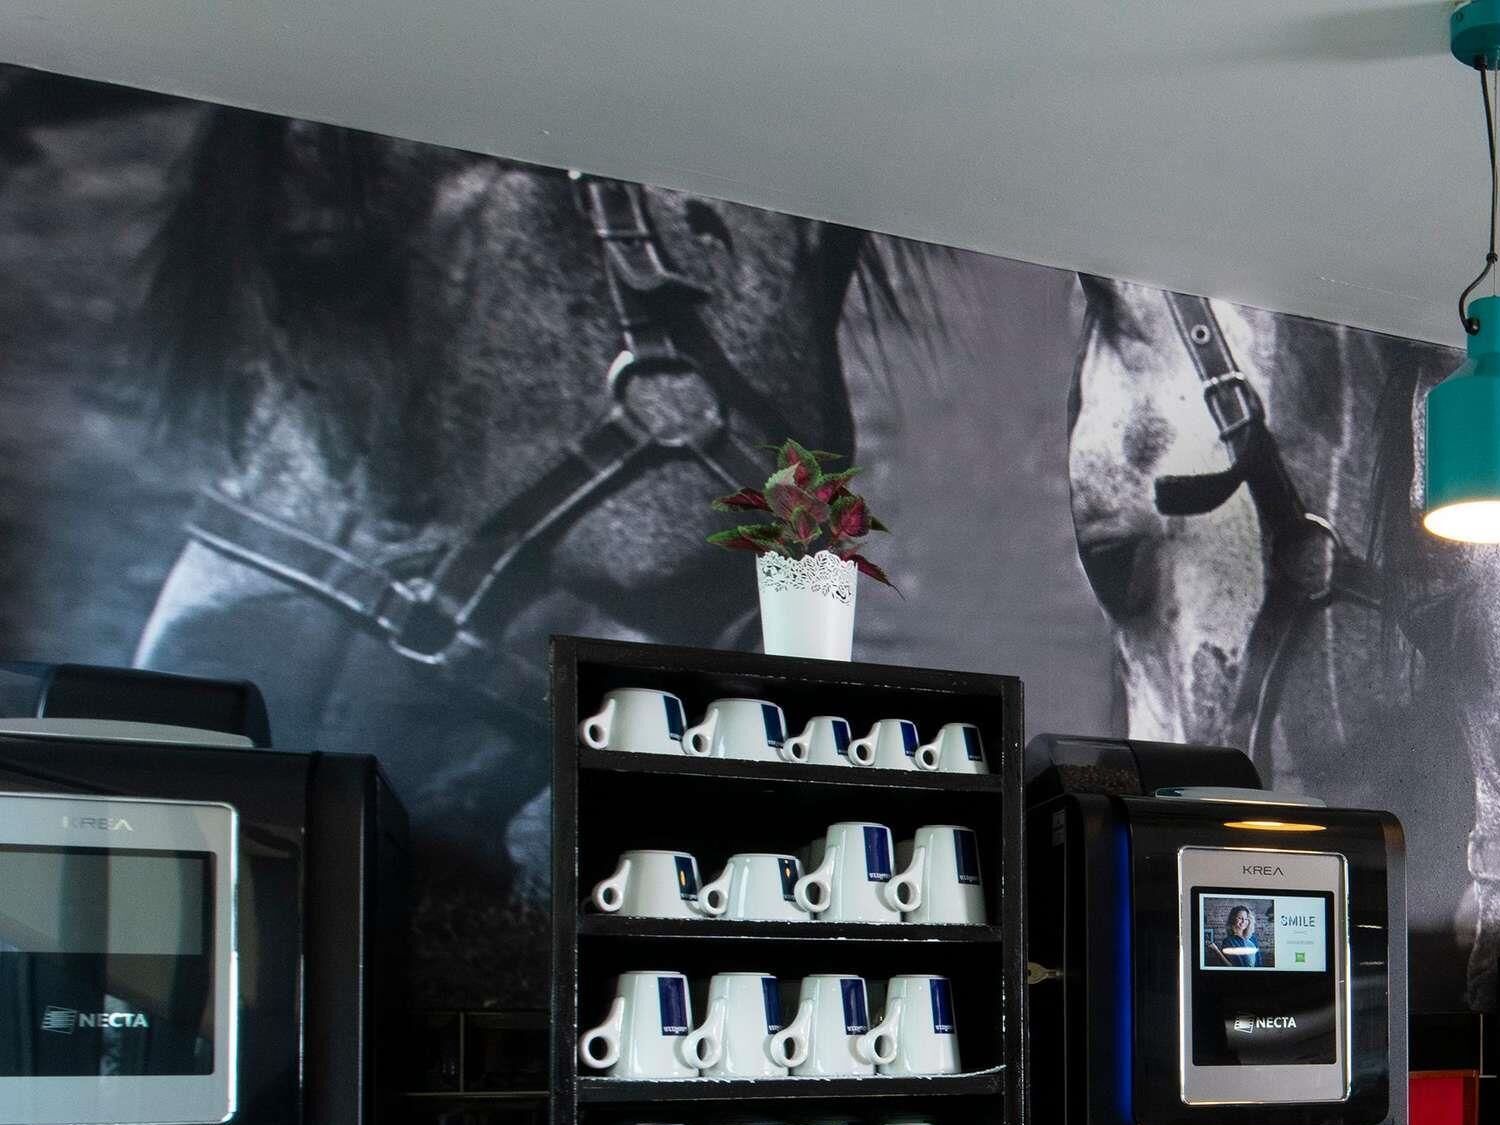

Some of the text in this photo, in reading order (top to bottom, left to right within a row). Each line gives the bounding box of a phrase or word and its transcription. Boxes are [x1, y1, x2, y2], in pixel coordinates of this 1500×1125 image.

[1242, 865, 1284, 876] KREA
[1280, 915, 1316, 928] SMILE
[79, 1012, 149, 1028] NECTA
[1256, 1016, 1297, 1029] NECTA
